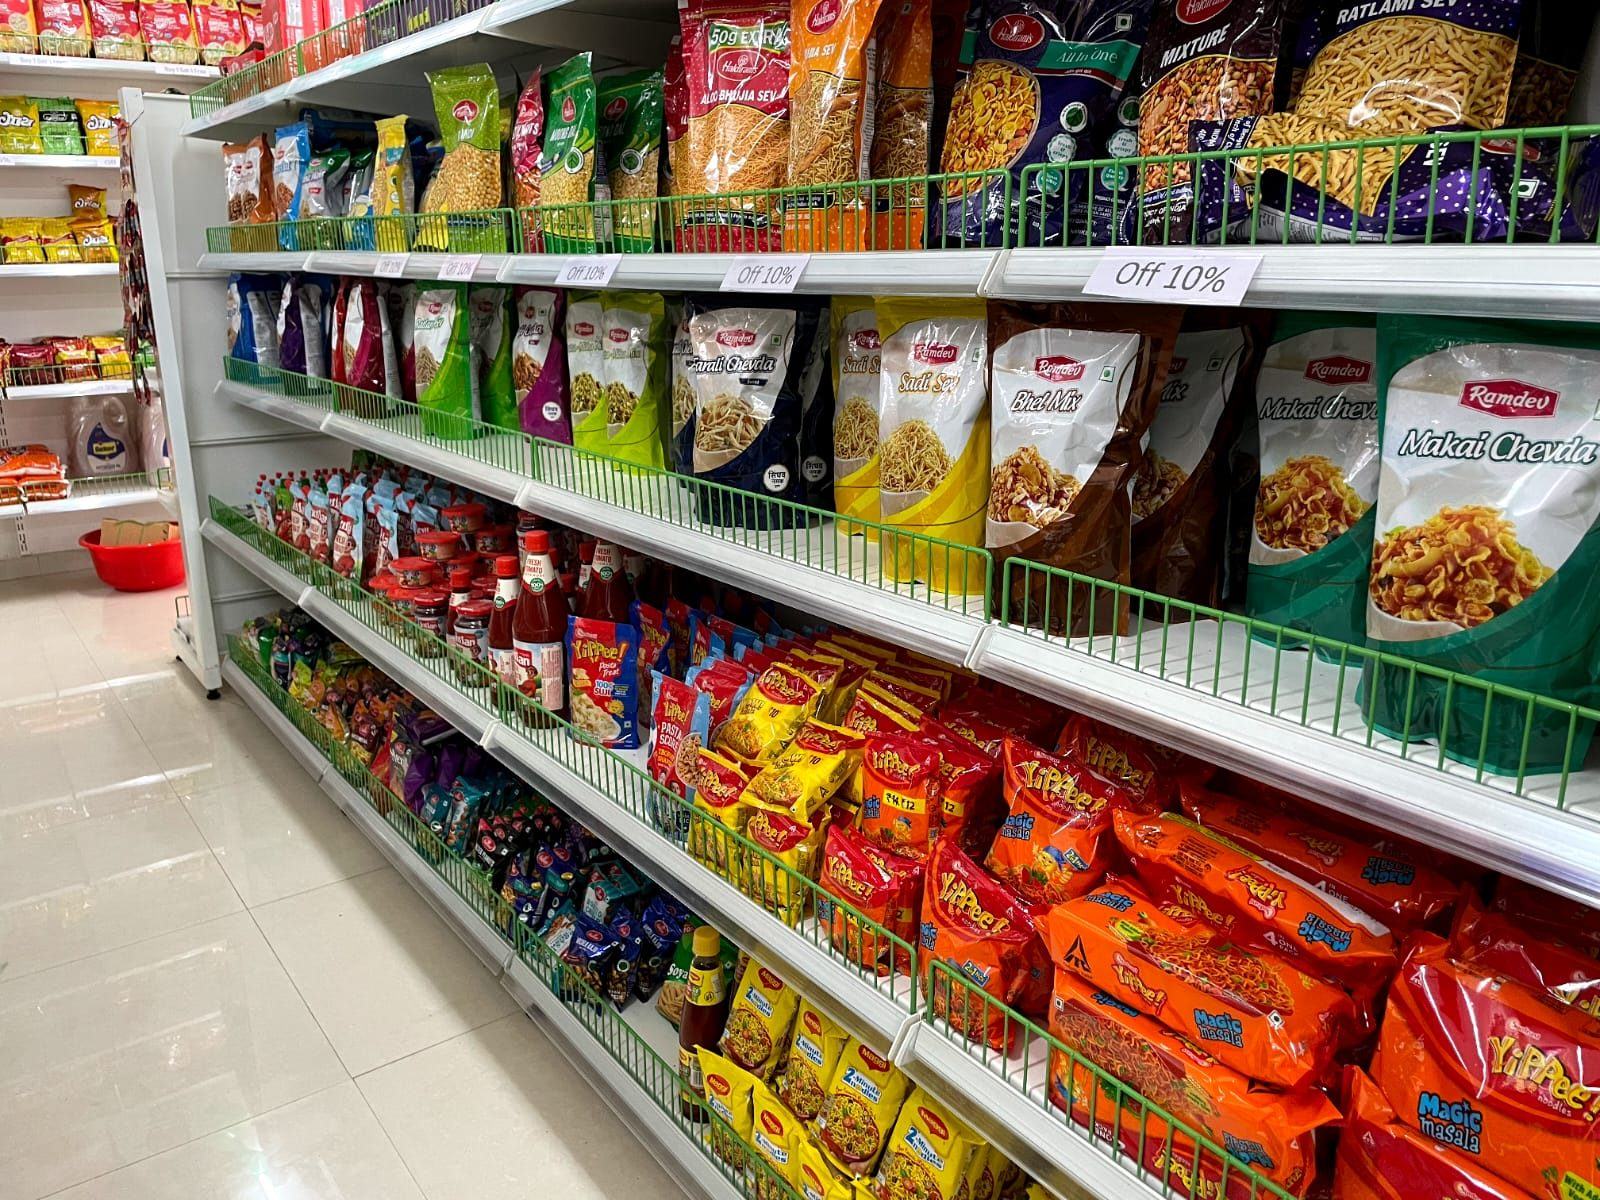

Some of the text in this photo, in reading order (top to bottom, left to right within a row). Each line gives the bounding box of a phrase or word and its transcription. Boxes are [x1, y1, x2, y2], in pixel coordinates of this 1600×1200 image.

[1336, 0, 1414, 25] RATLAMI
[711, 29, 738, 45] 50g
[1160, 23, 1231, 68] MIXTURE
[1056, 48, 1118, 63] All In One
[719, 90, 754, 102] BHUJIA
[757, 91, 777, 101] SEV
[457, 263, 472, 276] 10%
[567, 265, 606, 281] Off 10%
[737, 267, 796, 285] Off 10%
[1115, 262, 1231, 293] Off 10%
[720, 332, 754, 346] Ramdev
[916, 345, 954, 360] Ramdev
[726, 354, 777, 374] Chevda
[842, 355, 869, 374] Sadi
[1038, 359, 1081, 377] Ramdev
[1311, 361, 1366, 379] Ramdev
[899, 371, 961, 394] Sadi Sev
[1010, 388, 1083, 413] Bhel Mix
[1469, 384, 1550, 410] Ramdev
[1259, 394, 1378, 420] Makai Chev
[1397, 428, 1598, 465] Makai Chevda
[661, 721, 683, 740] PASTA
[667, 963, 689, 980] Soya
[1199, 1026, 1243, 1048] masala
[1537, 1094, 1572, 1118] noodles
[1419, 1116, 1481, 1154] masala
[1564, 1172, 1585, 1193] With
